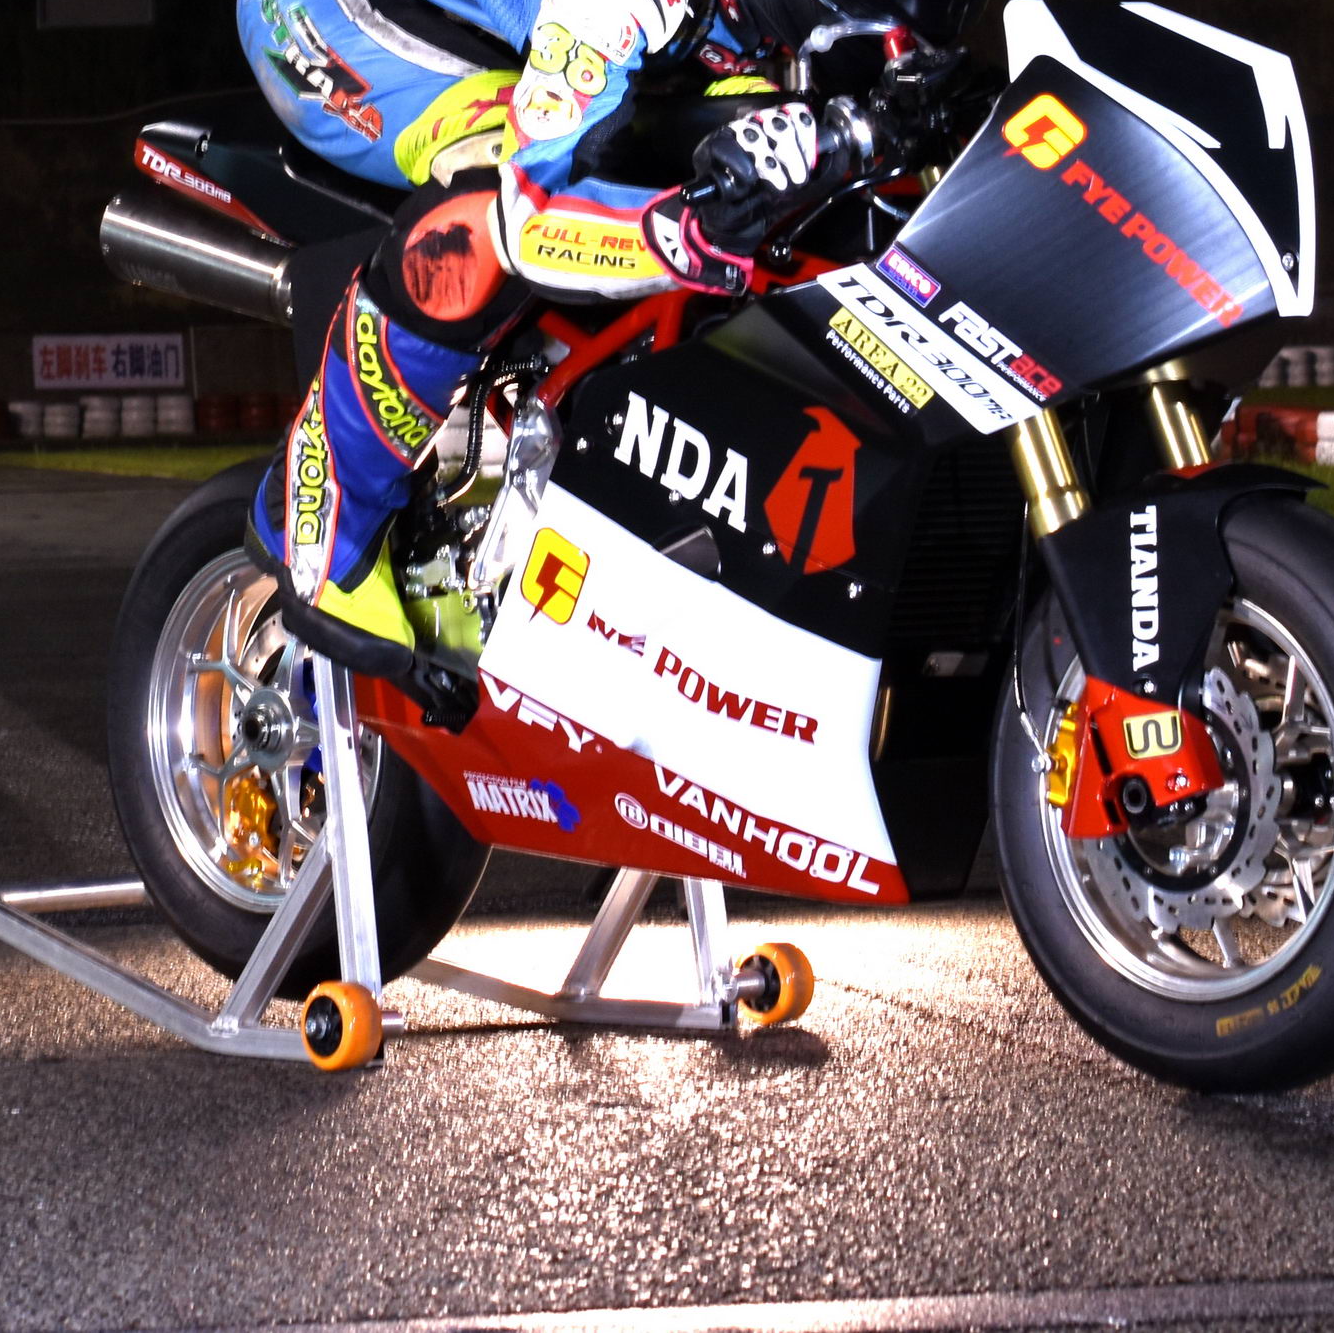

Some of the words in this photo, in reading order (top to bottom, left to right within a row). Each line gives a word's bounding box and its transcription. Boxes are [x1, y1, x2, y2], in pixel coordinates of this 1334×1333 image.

[537, 244, 636, 270] RACING
[1120, 212, 1243, 328] POWER
[39, 343, 108, 380] 左脚刹车
[111, 342, 180, 379] 右脚油门
[356, 312, 432, 448] daytona
[826, 328, 883, 389] Performance
[881, 379, 911, 414] Parts
[835, 317, 902, 382] AREA
[614, 391, 748, 533] NDA
[1130, 504, 1161, 672] TIANDA
[653, 645, 819, 745] POWER
[466, 781, 559, 824] MATRIX
[654, 762, 880, 896] VANHOOL
